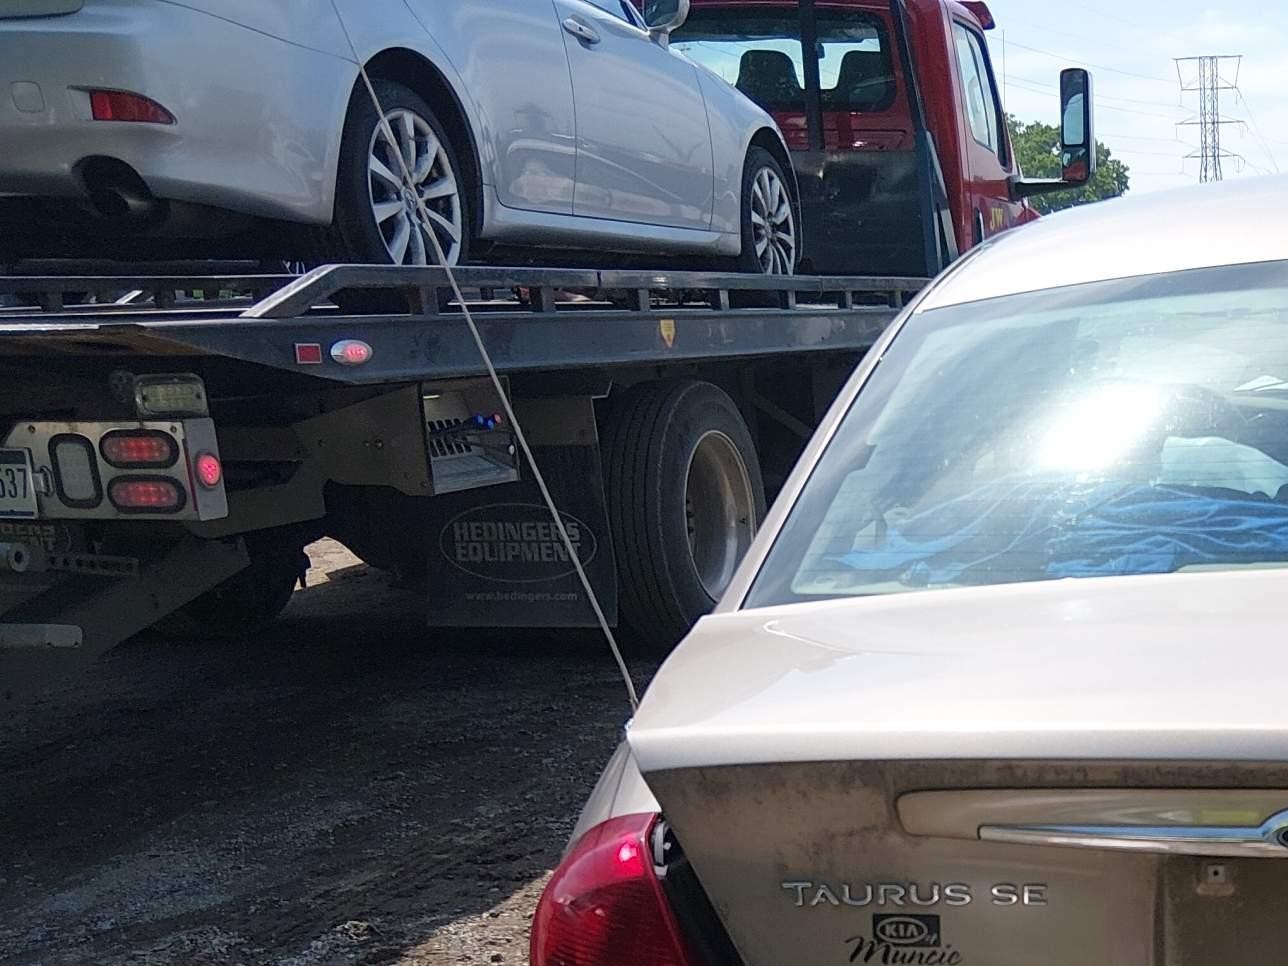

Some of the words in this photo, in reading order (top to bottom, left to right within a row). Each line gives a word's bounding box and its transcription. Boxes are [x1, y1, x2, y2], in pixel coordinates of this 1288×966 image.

[453, 520, 581, 542] HEDINGERS
[781, 880, 973, 907] TAURUS
[991, 883, 1049, 907] SE
[884, 922, 920, 938] KIA
